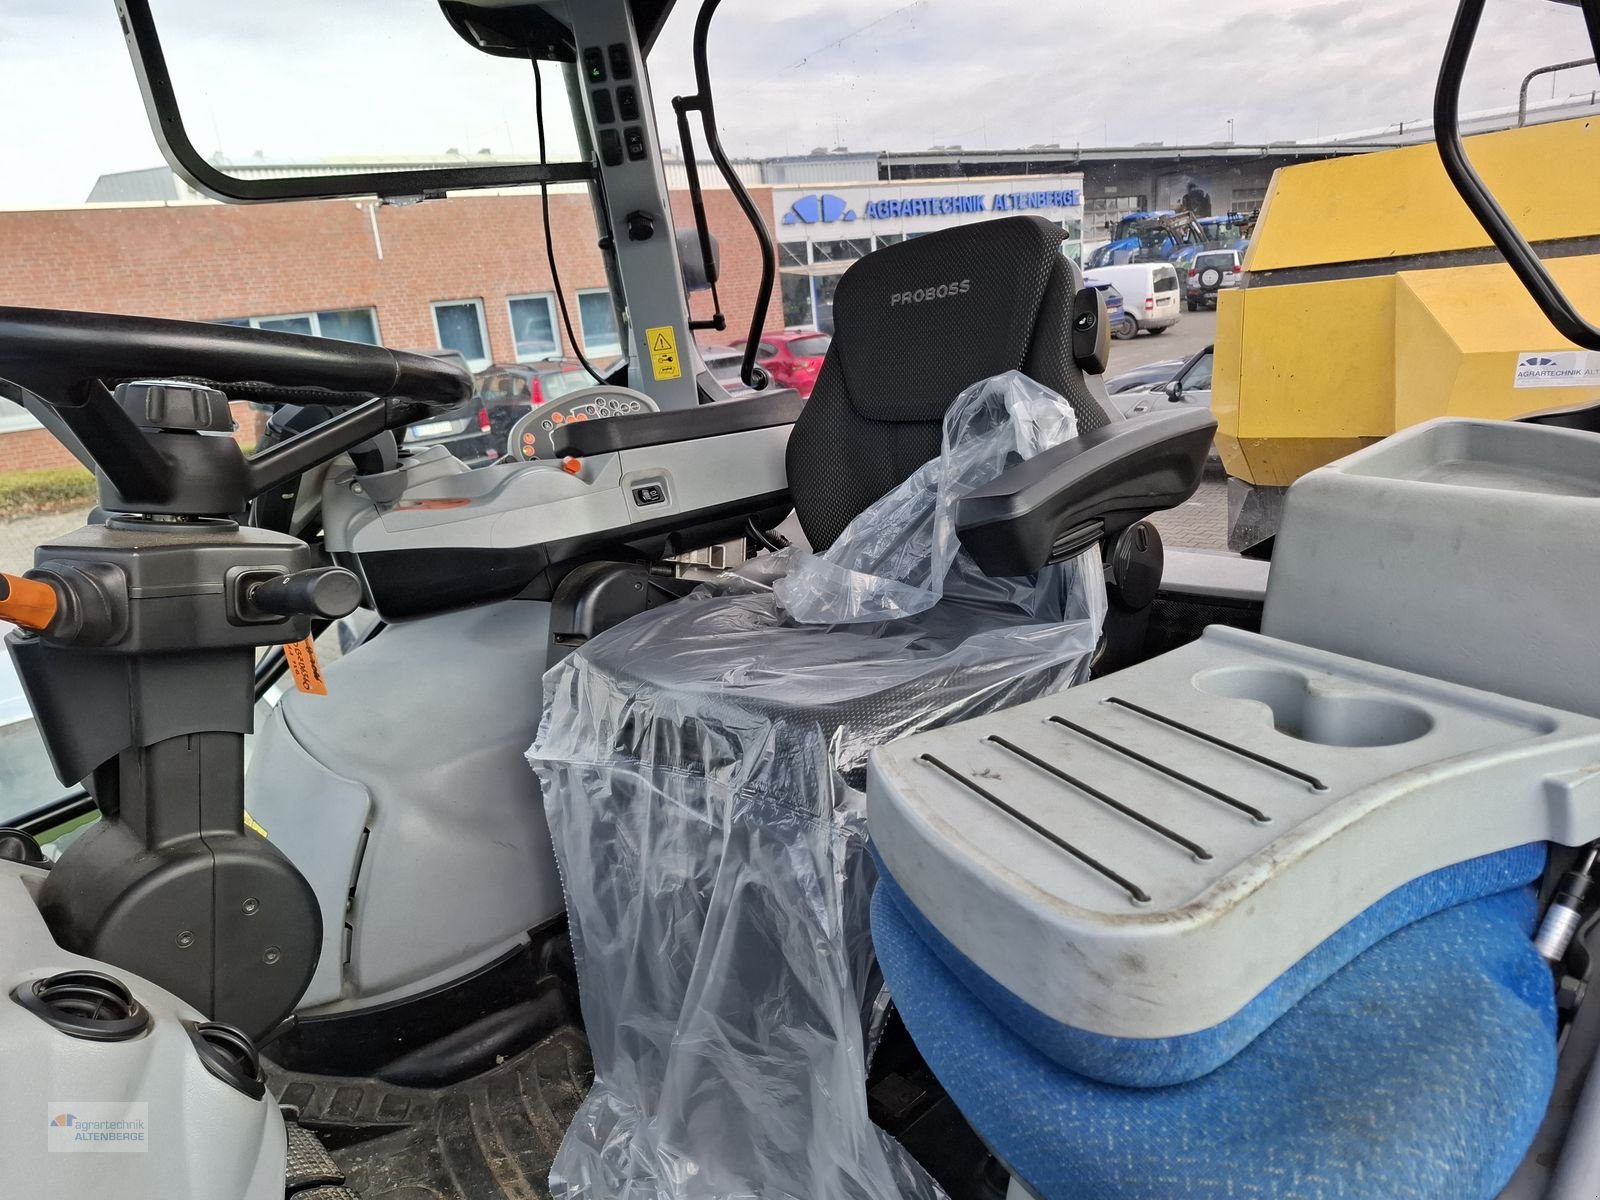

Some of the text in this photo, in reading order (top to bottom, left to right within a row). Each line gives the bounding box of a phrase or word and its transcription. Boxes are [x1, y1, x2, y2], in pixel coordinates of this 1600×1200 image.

[865, 189, 1081, 219] AGRARTECHNIK ALTENBERGE
[890, 279, 970, 307] PROBOSS
[1518, 369, 1582, 377] AGRARTECHNIK
